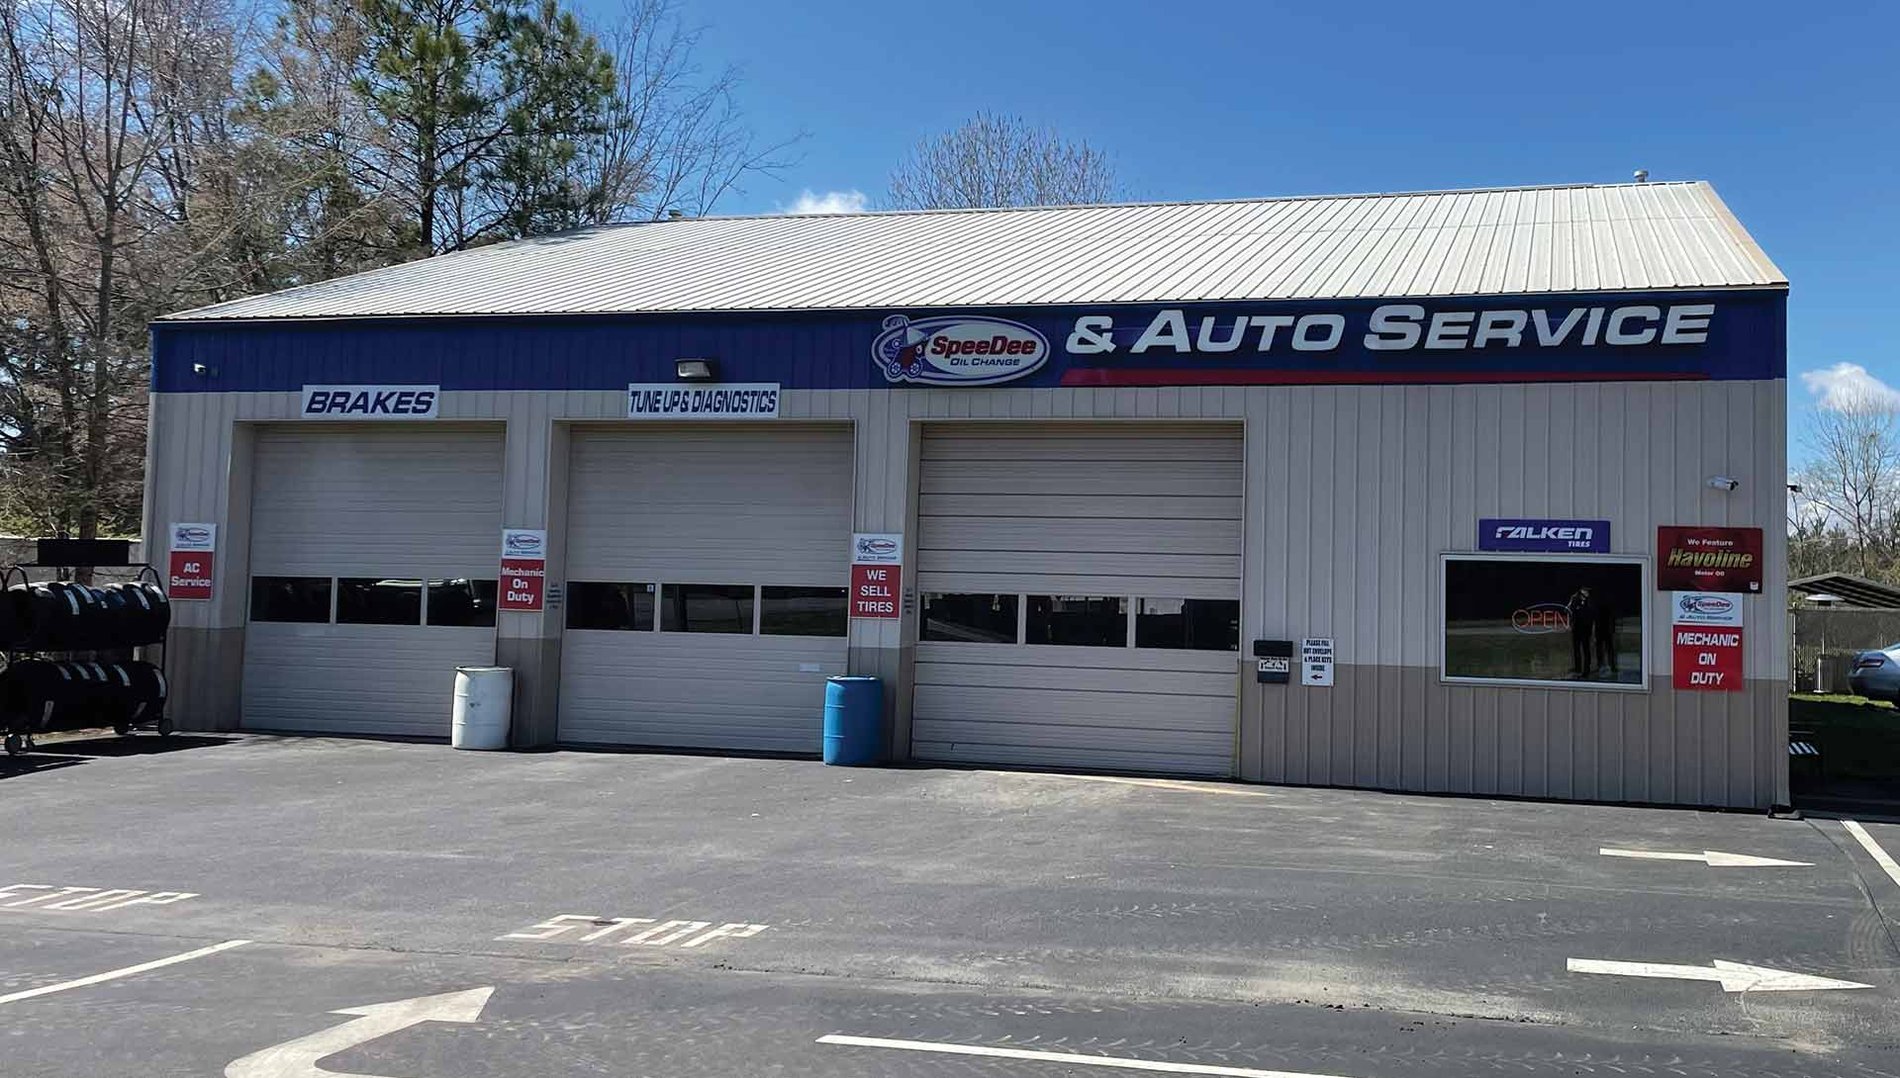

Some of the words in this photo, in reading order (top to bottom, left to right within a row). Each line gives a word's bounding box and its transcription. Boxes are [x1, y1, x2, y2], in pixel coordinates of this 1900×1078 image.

[1065, 315, 1116, 354] &
[1130, 309, 1345, 354] AUTO
[1363, 303, 1716, 351] SERVICE
[931, 335, 1037, 356] SpeeDee
[950, 357, 970, 367] OIL
[971, 357, 1021, 367] CHANGE
[305, 391, 436, 414] BRAKES
[630, 390, 663, 413] TUNE
[691, 390, 777, 413] DIAGNOSTICS
[1495, 526, 1593, 540] FALKEN
[1567, 540, 1591, 548] TIRES
[1687, 538, 1700, 546] We
[1702, 538, 1733, 547] Feature
[1667, 548, 1753, 569] Havoline
[183, 562, 201, 574] AC
[501, 567, 545, 577] Mechanic
[171, 575, 211, 587] Service
[866, 569, 887, 581] WE
[512, 578, 529, 589] On
[507, 590, 535, 605] Duty
[860, 585, 891, 597] SELL
[857, 601, 894, 613] TIRES
[1512, 609, 1570, 630] OPEN
[1676, 632, 1740, 647] MECHANIC
[1698, 652, 1717, 666] ON
[1690, 672, 1724, 685] DUTY
[493, 914, 770, 948] STOP
